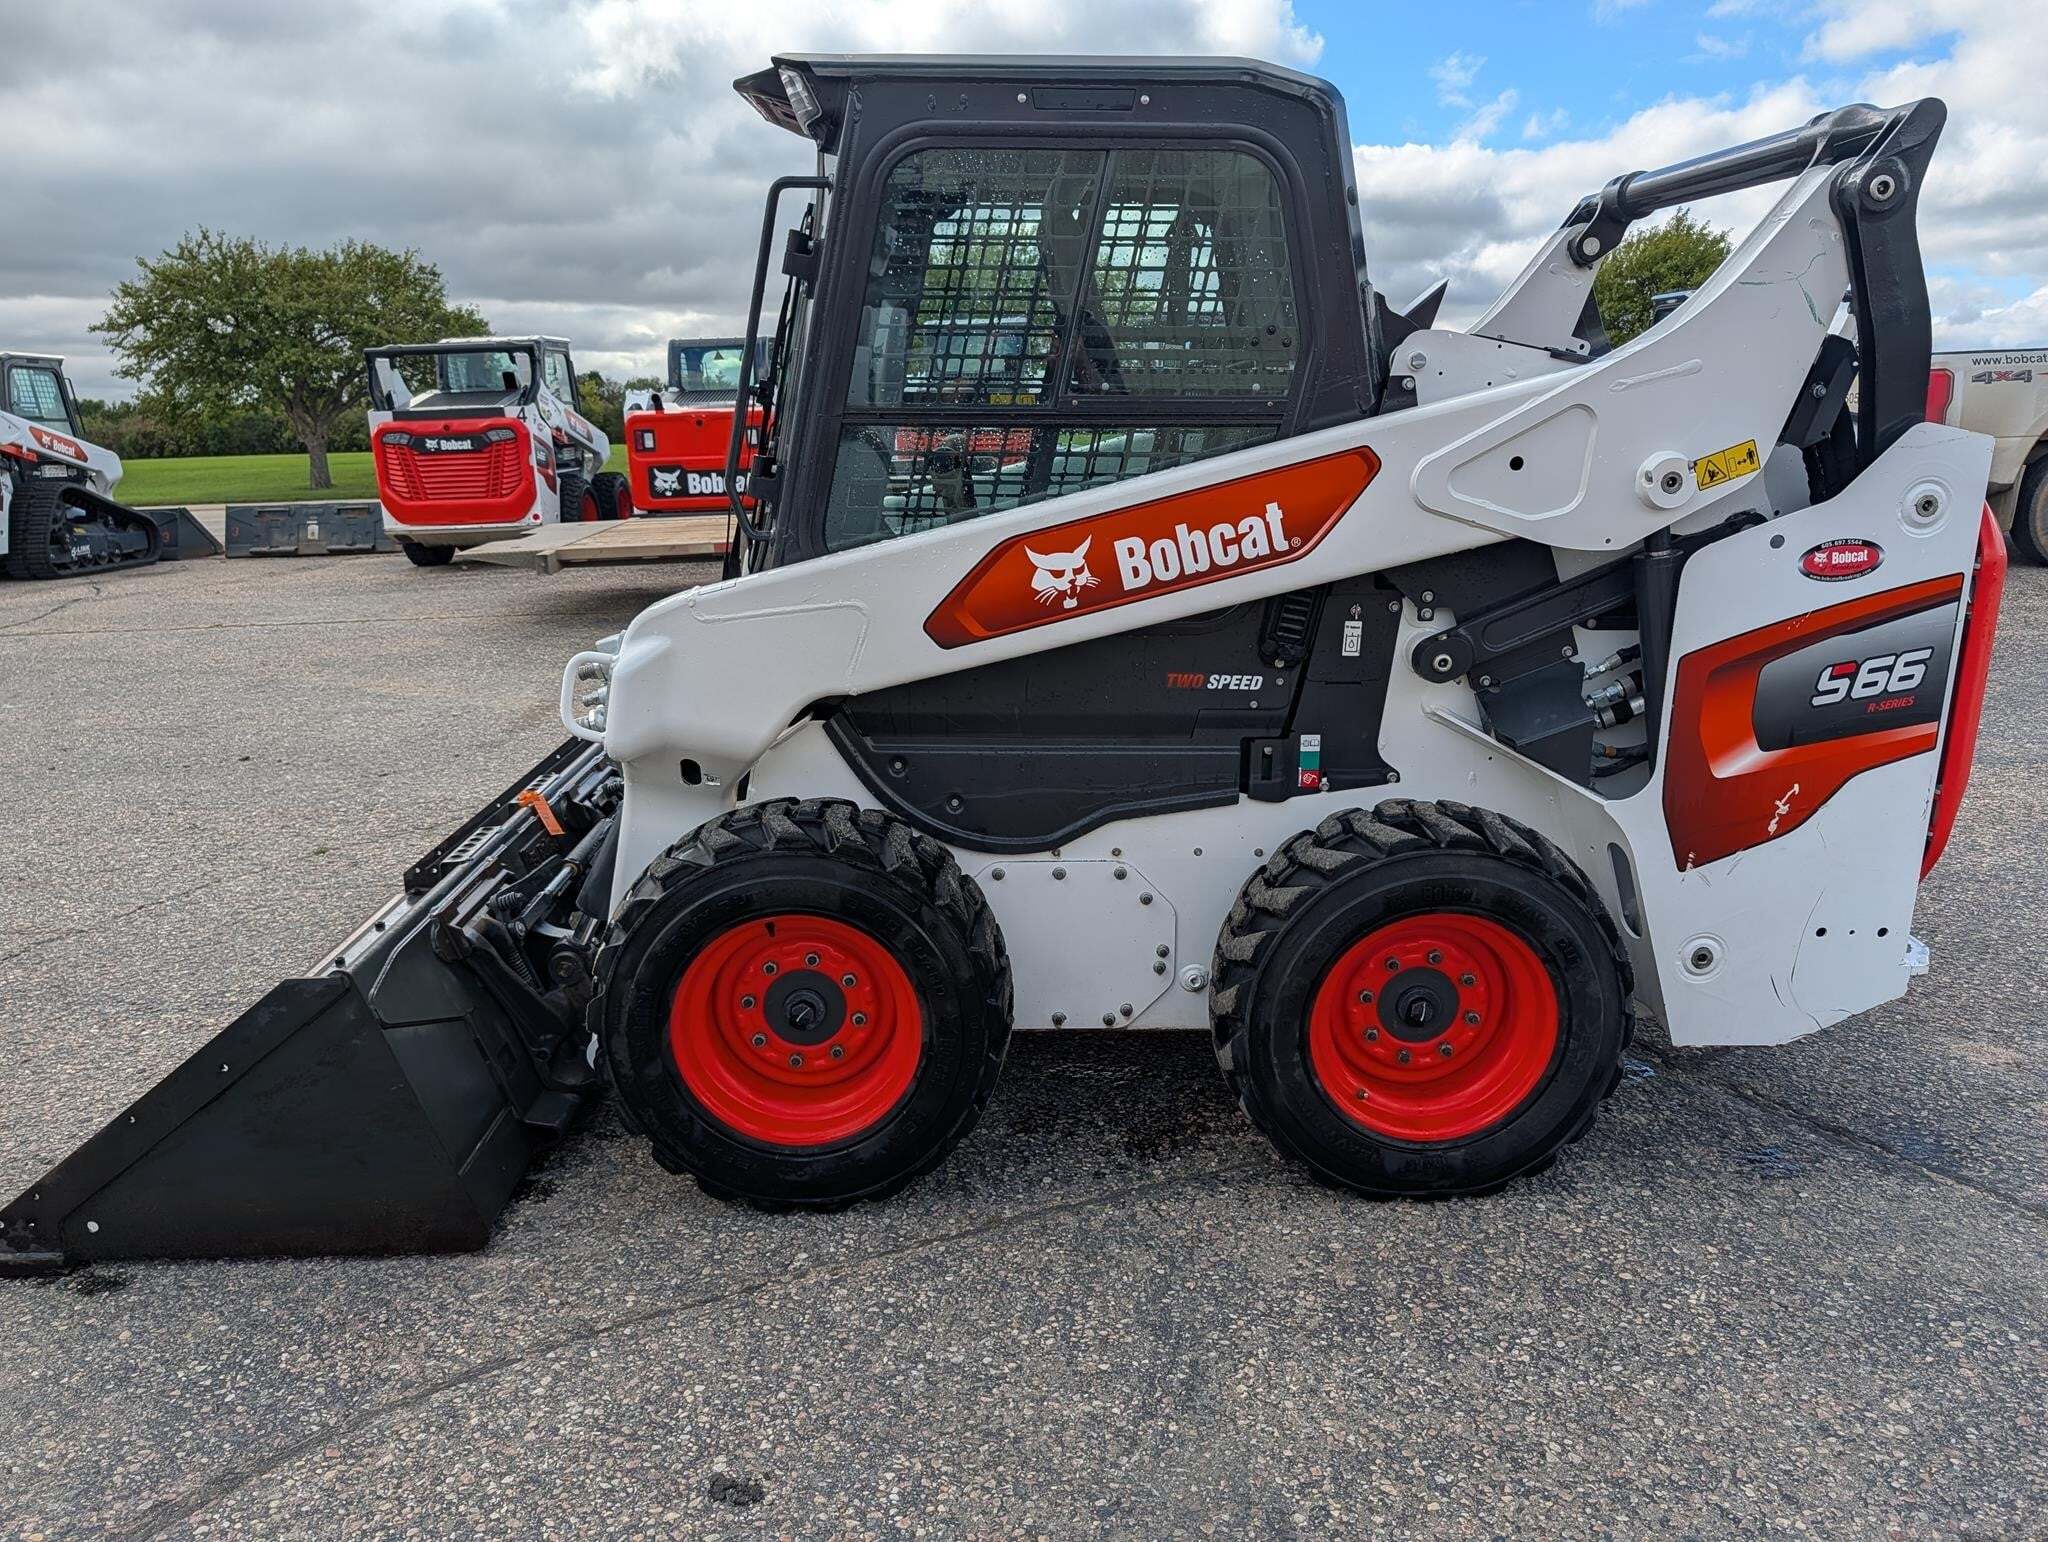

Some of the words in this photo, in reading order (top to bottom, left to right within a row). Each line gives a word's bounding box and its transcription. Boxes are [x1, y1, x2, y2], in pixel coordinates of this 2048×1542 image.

[52, 439, 76, 457] Bobcat
[440, 438, 472, 451] Bobcat
[687, 472, 752, 494] Boba
[1831, 549, 1869, 565] Bobcat
[1167, 673, 1205, 689] TWO
[1206, 674, 1264, 690] SPEED
[1811, 646, 1934, 707] S66
[1867, 696, 1915, 713] R-SERIES
